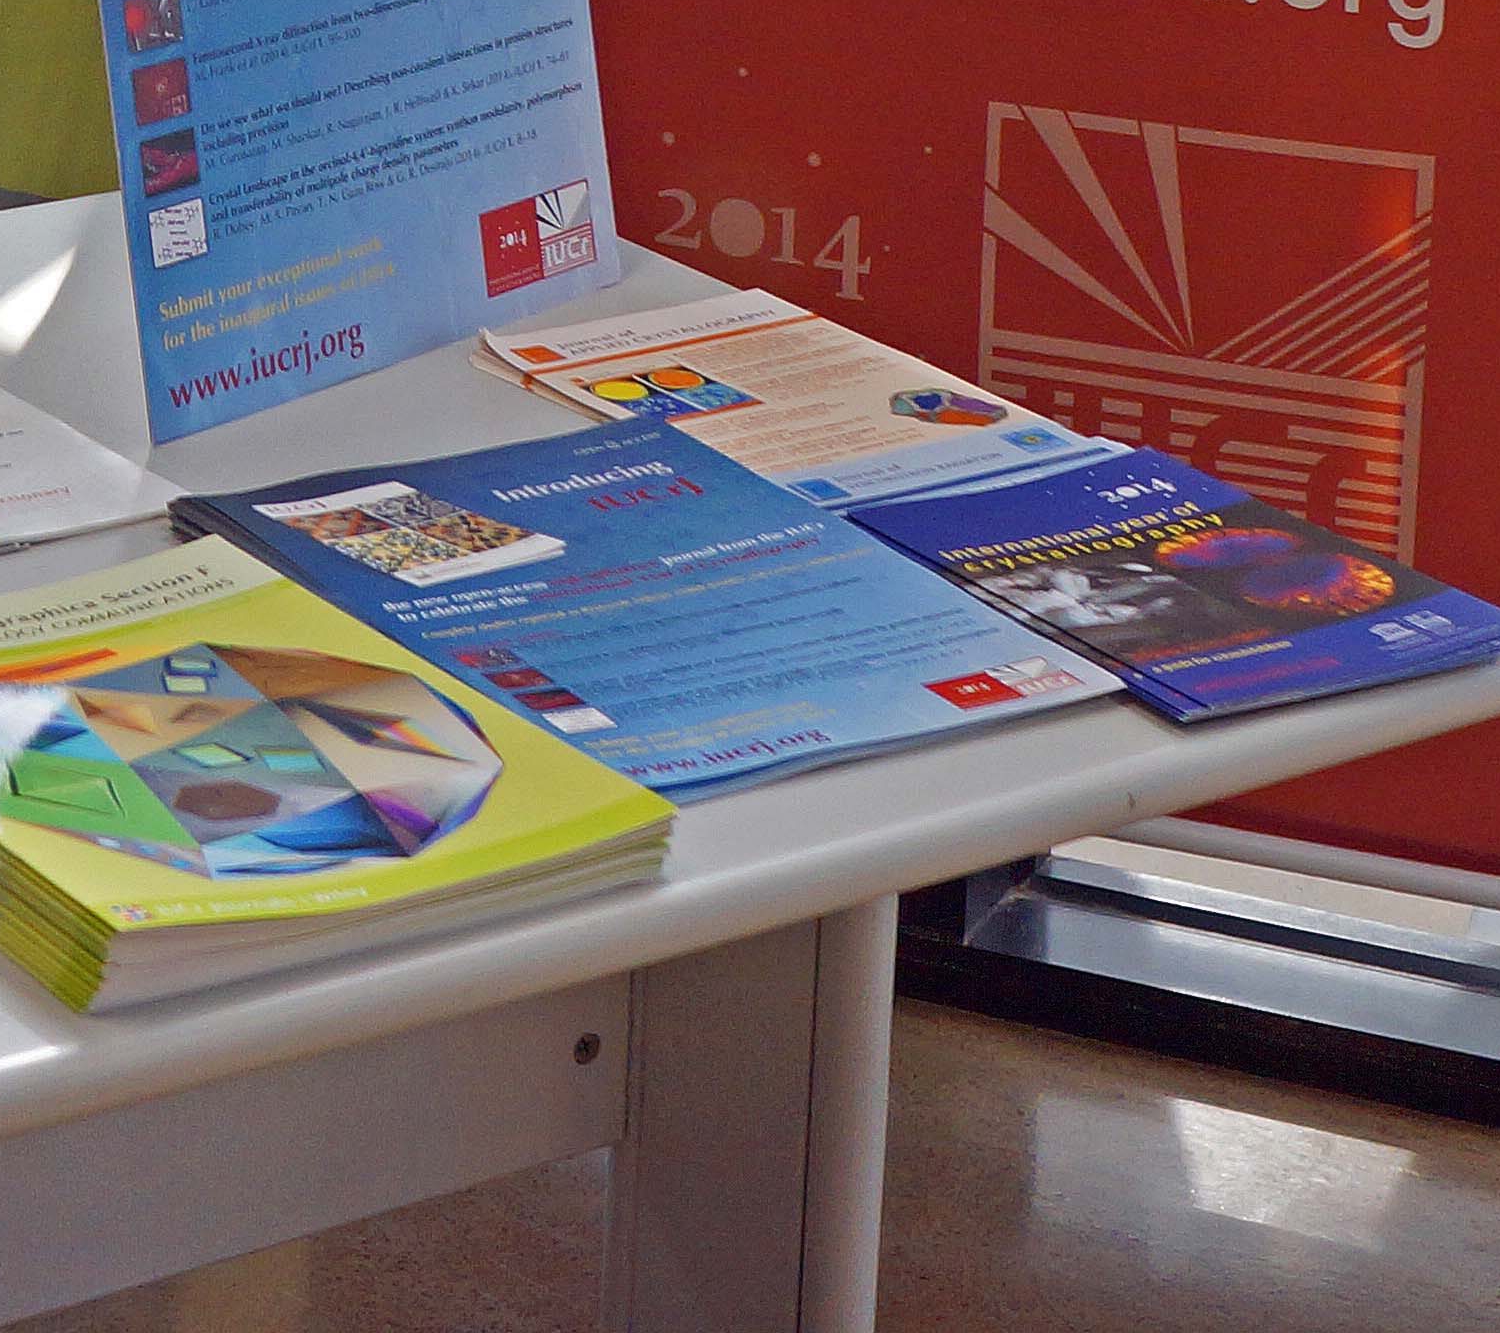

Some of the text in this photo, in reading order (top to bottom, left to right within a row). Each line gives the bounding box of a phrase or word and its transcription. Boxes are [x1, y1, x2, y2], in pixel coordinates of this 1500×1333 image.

[656, 188, 871, 300] 2014
[170, 323, 364, 407] www.iucrj.org
[493, 459, 674, 503] Introducing
[1097, 476, 1178, 506] 2014
[939, 500, 1201, 564] International year of
